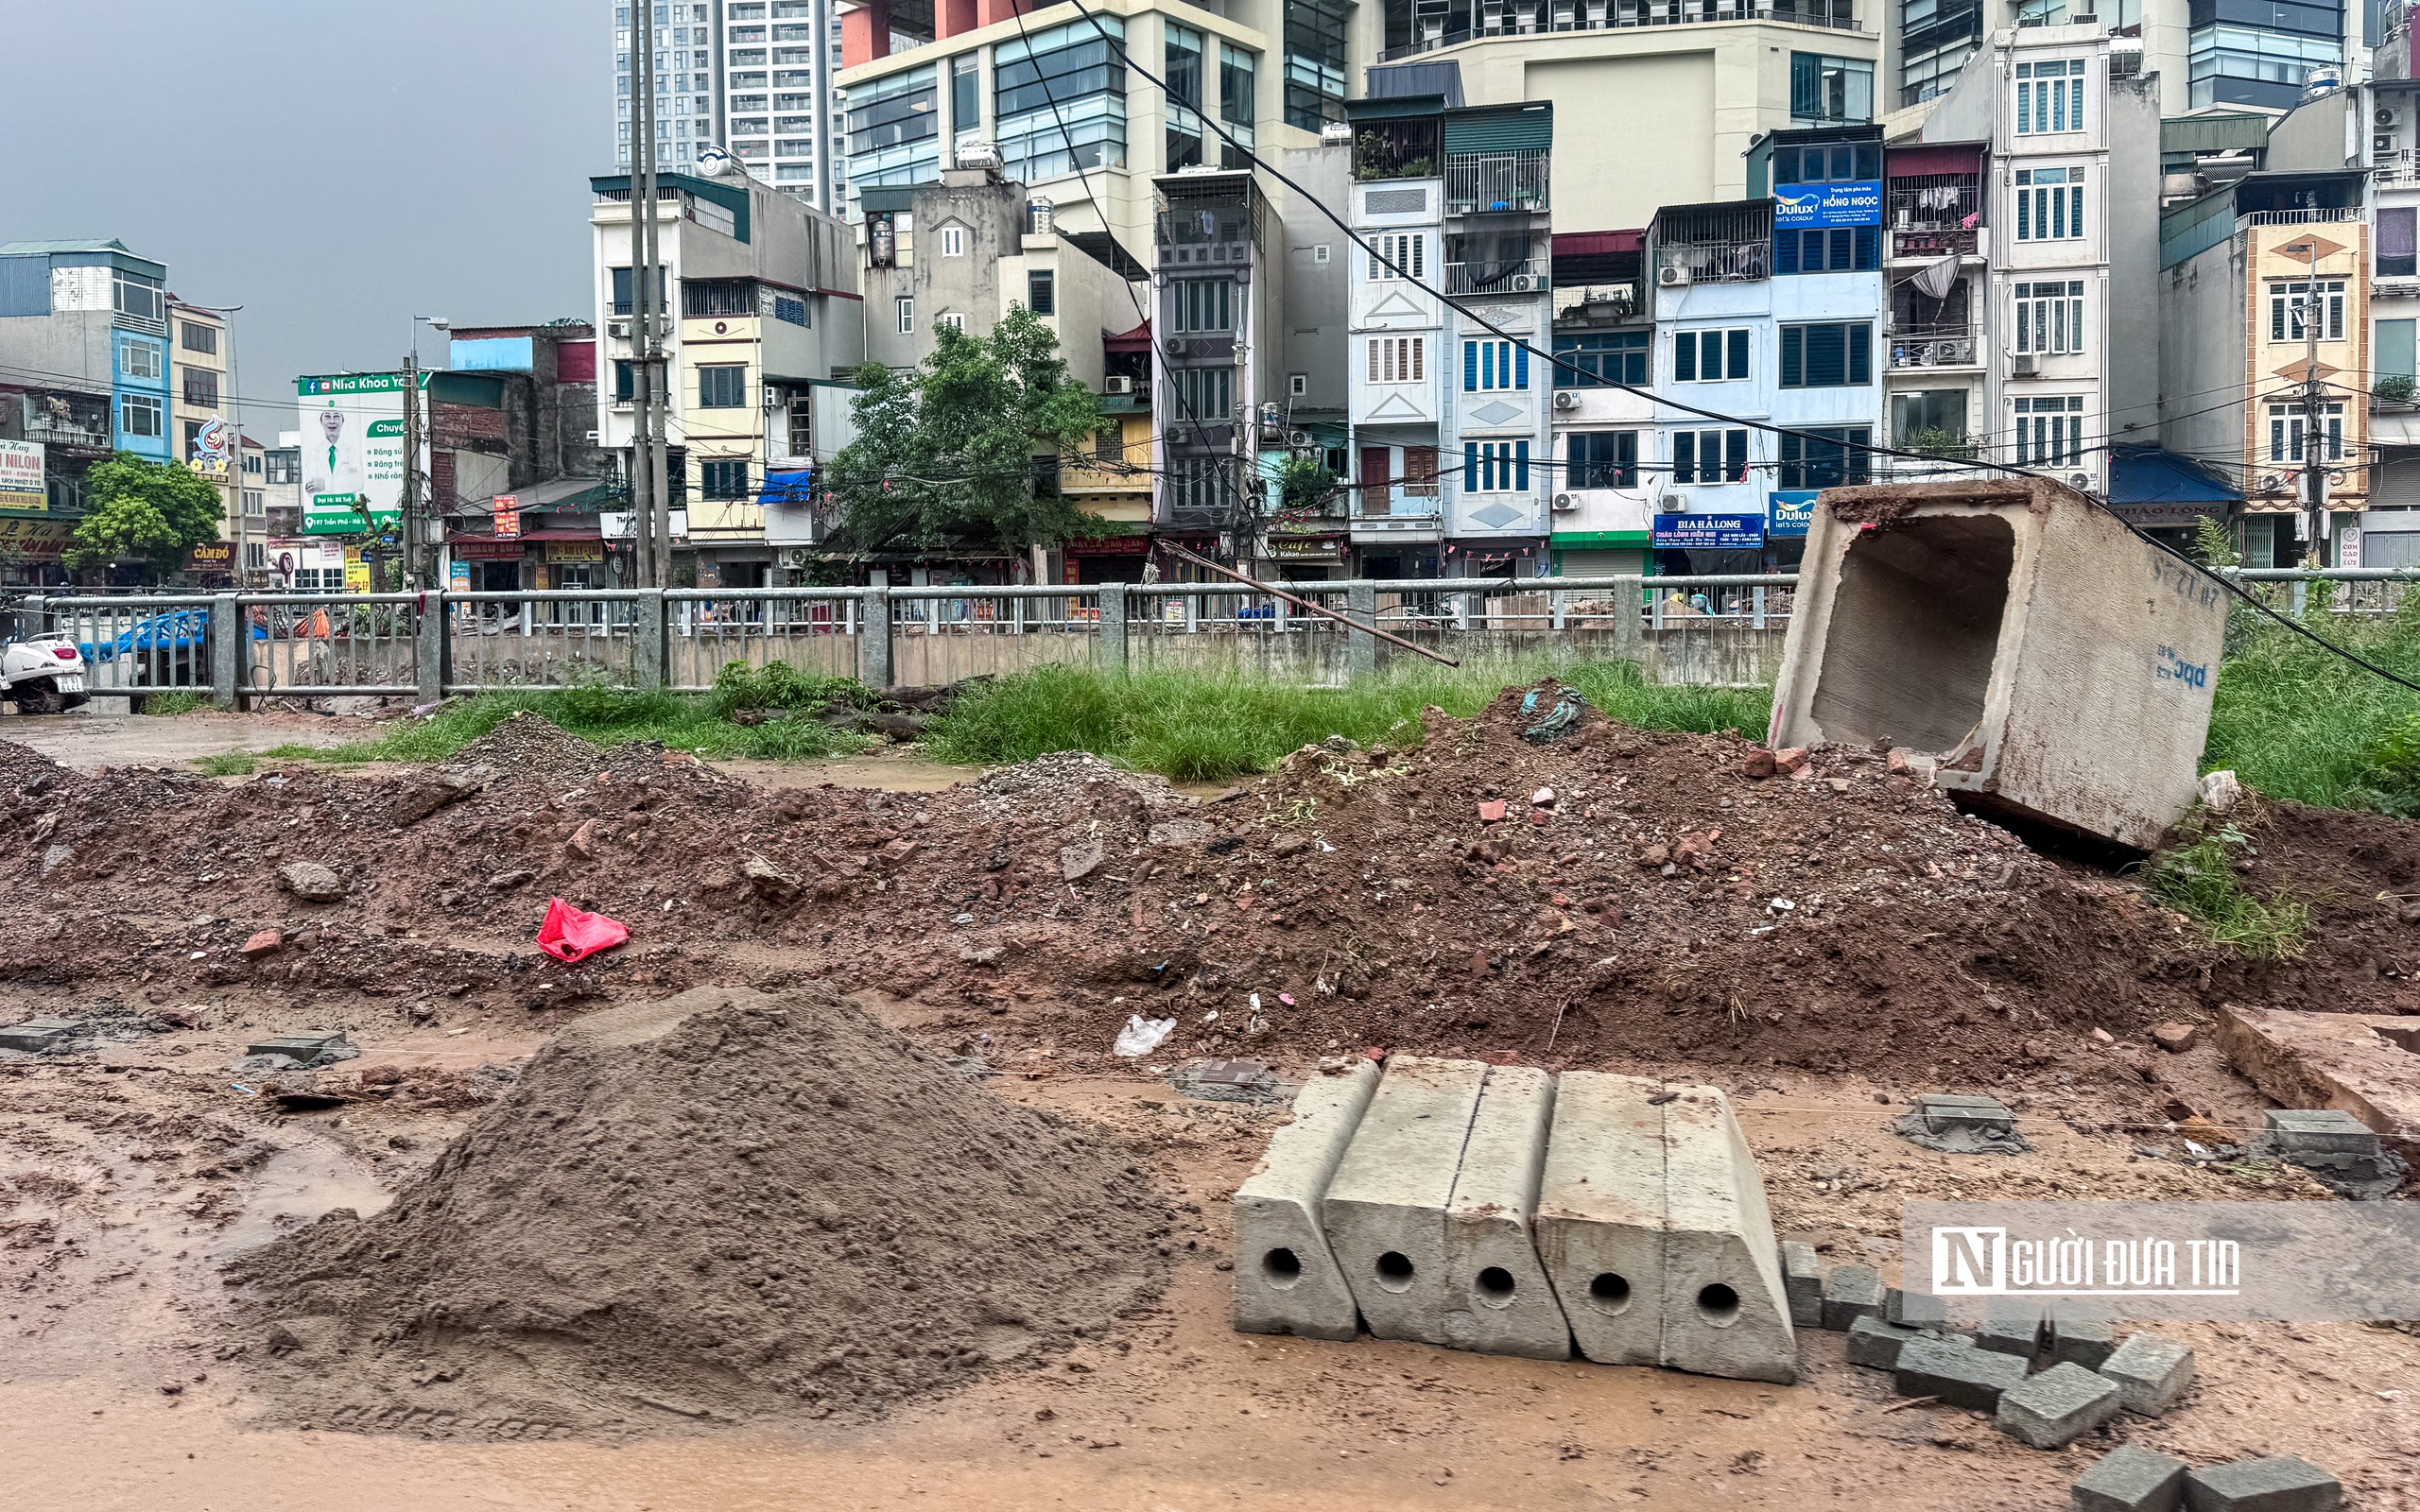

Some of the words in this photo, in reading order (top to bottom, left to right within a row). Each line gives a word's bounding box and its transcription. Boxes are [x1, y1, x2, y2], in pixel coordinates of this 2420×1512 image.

[1851, 196, 1878, 208] NGỌC
[1775, 203, 1814, 215] Dulux
[333, 378, 355, 390] Nha
[359, 376, 389, 388] Khoa
[376, 421, 405, 433] Chuyê
[9, 440, 29, 454] Huy
[373, 448, 392, 457] Răng
[6, 453, 41, 471] NILON
[373, 459, 392, 469] Răng
[1775, 509, 1813, 521] Dulux
[1677, 520, 1697, 529] BIA
[1714, 520, 1741, 529] LONG
